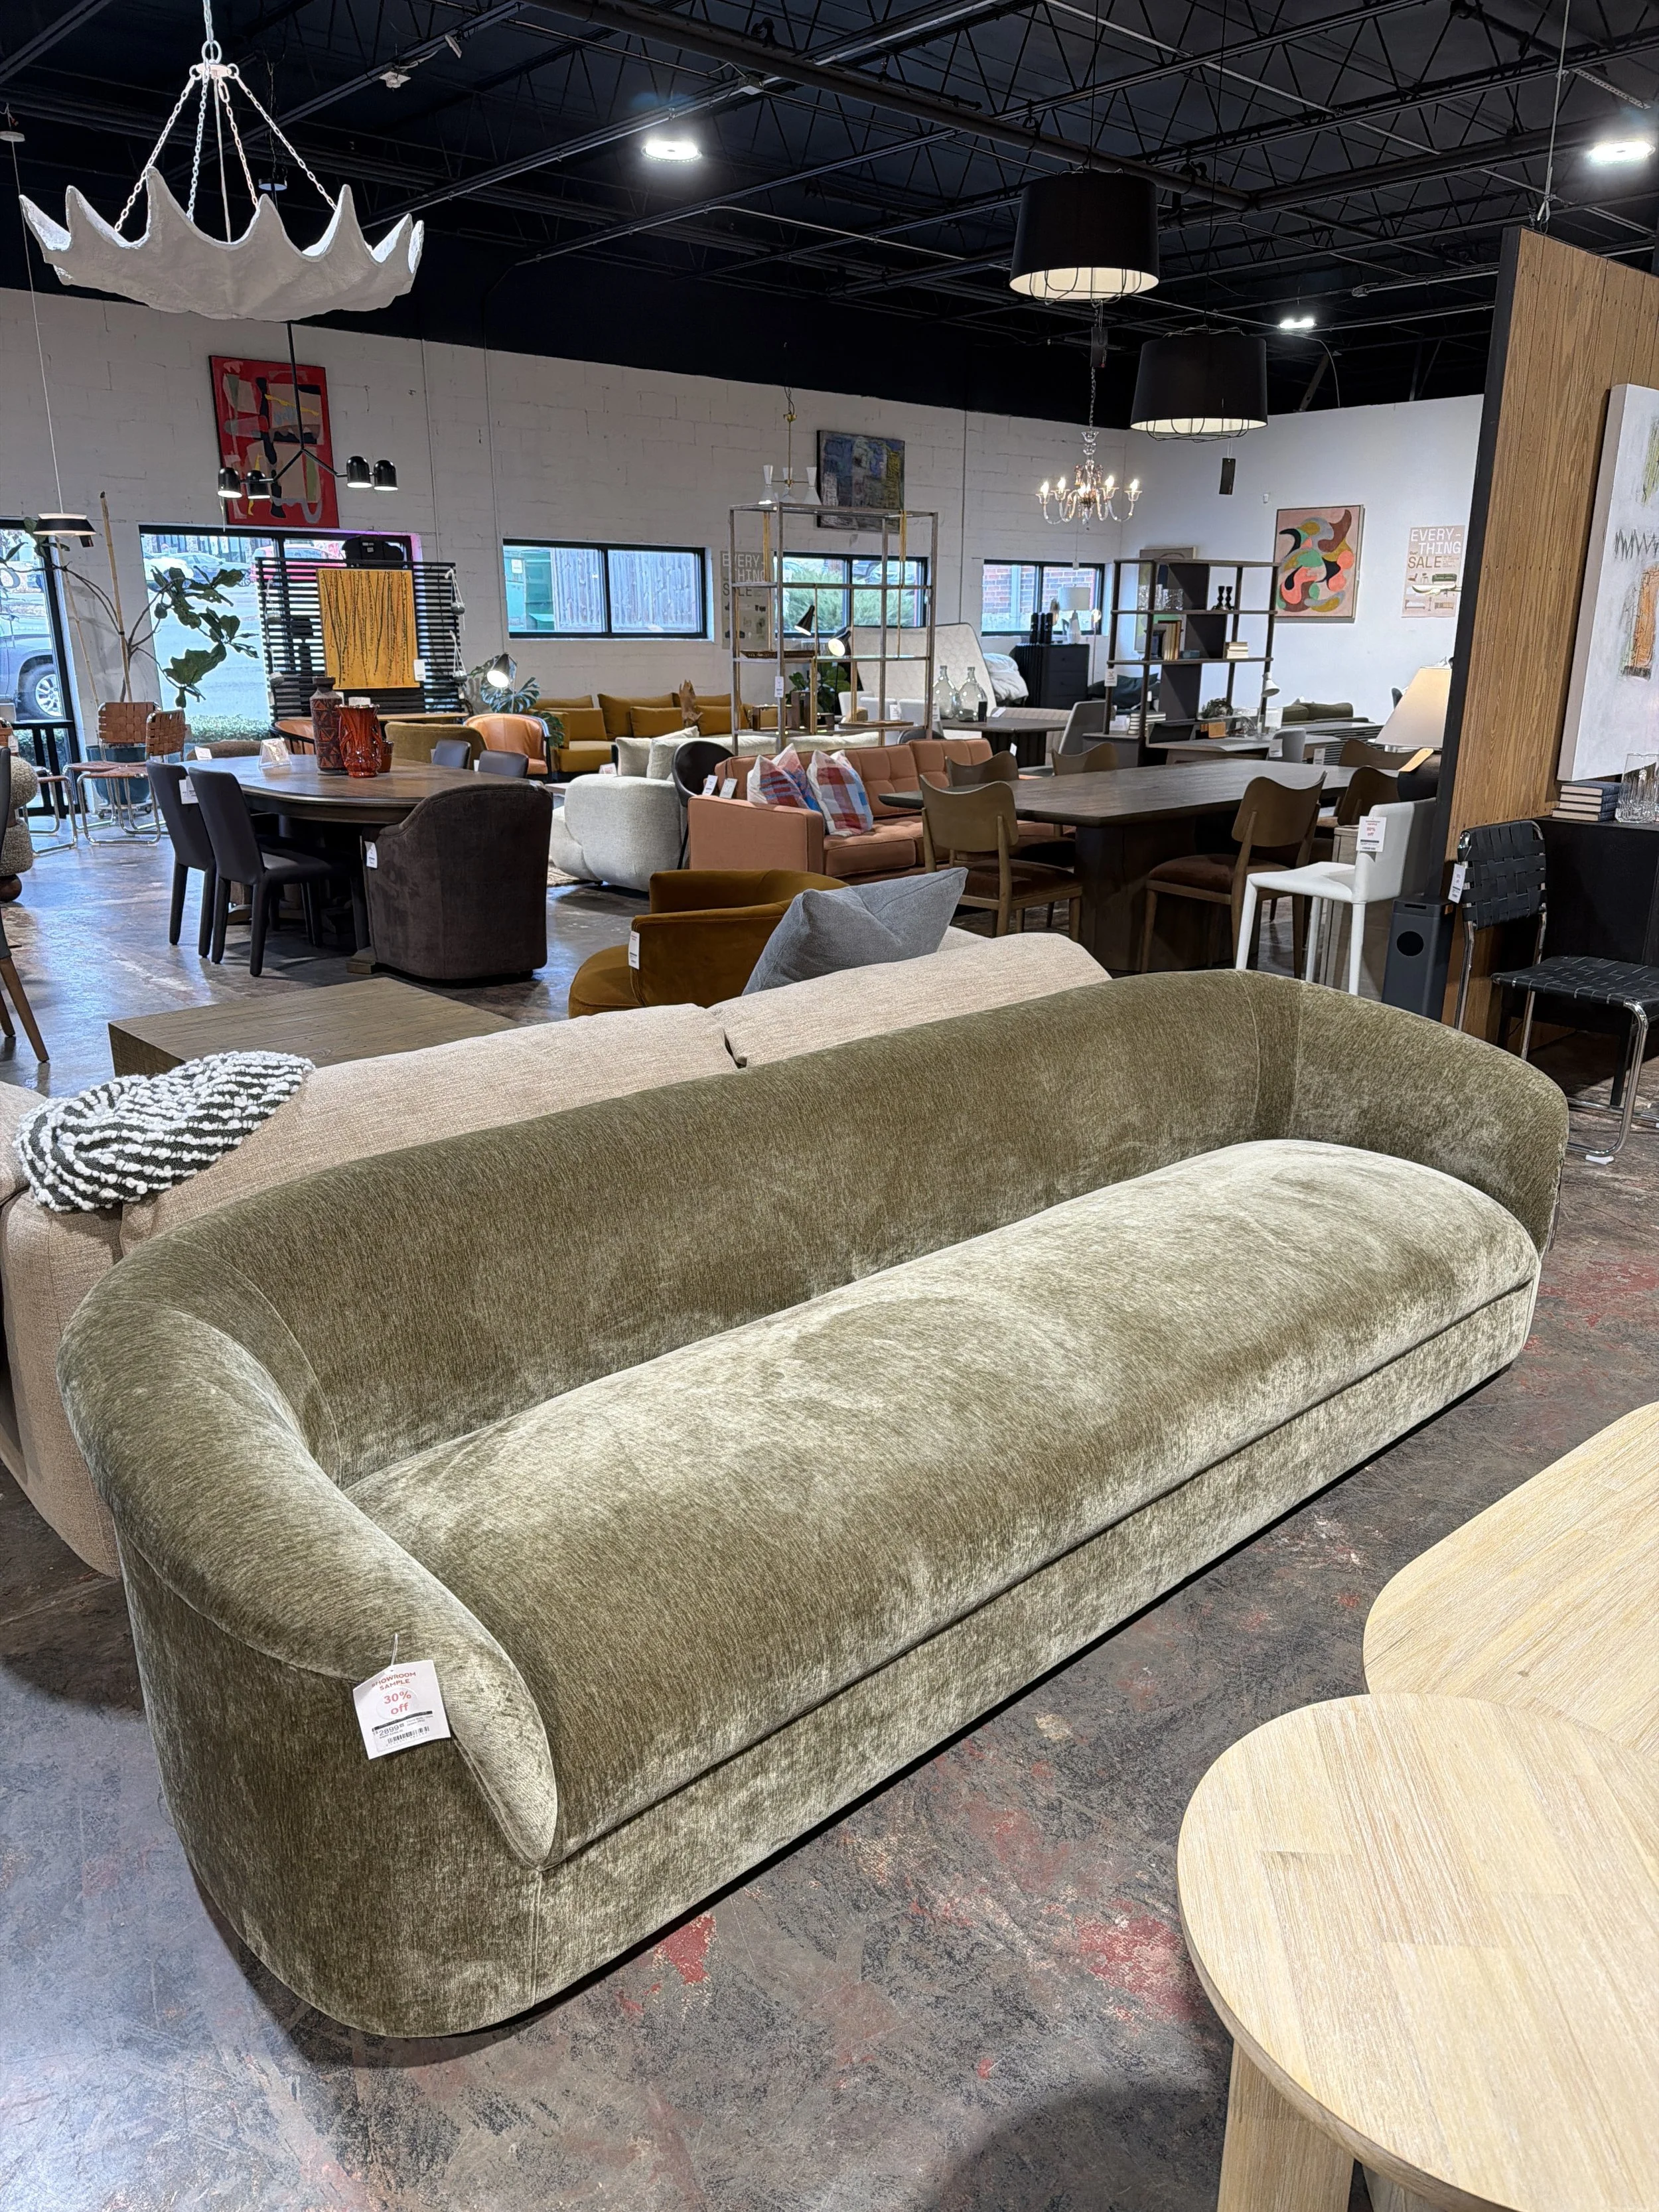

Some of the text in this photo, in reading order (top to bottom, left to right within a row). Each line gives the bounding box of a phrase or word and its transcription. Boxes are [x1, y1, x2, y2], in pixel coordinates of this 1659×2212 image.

[1411, 528, 1461, 542] EVERY-
[1419, 542, 1461, 555] THING
[722, 553, 764, 567] EERY-
[1407, 556, 1442, 569] SALE
[723, 583, 752, 597] SLE
[372, 1672, 417, 1688] SHOWROOM
[380, 1679, 411, 1690] SAMPLE
[384, 1691, 411, 1704] 30%
[390, 1702, 409, 1715] off
